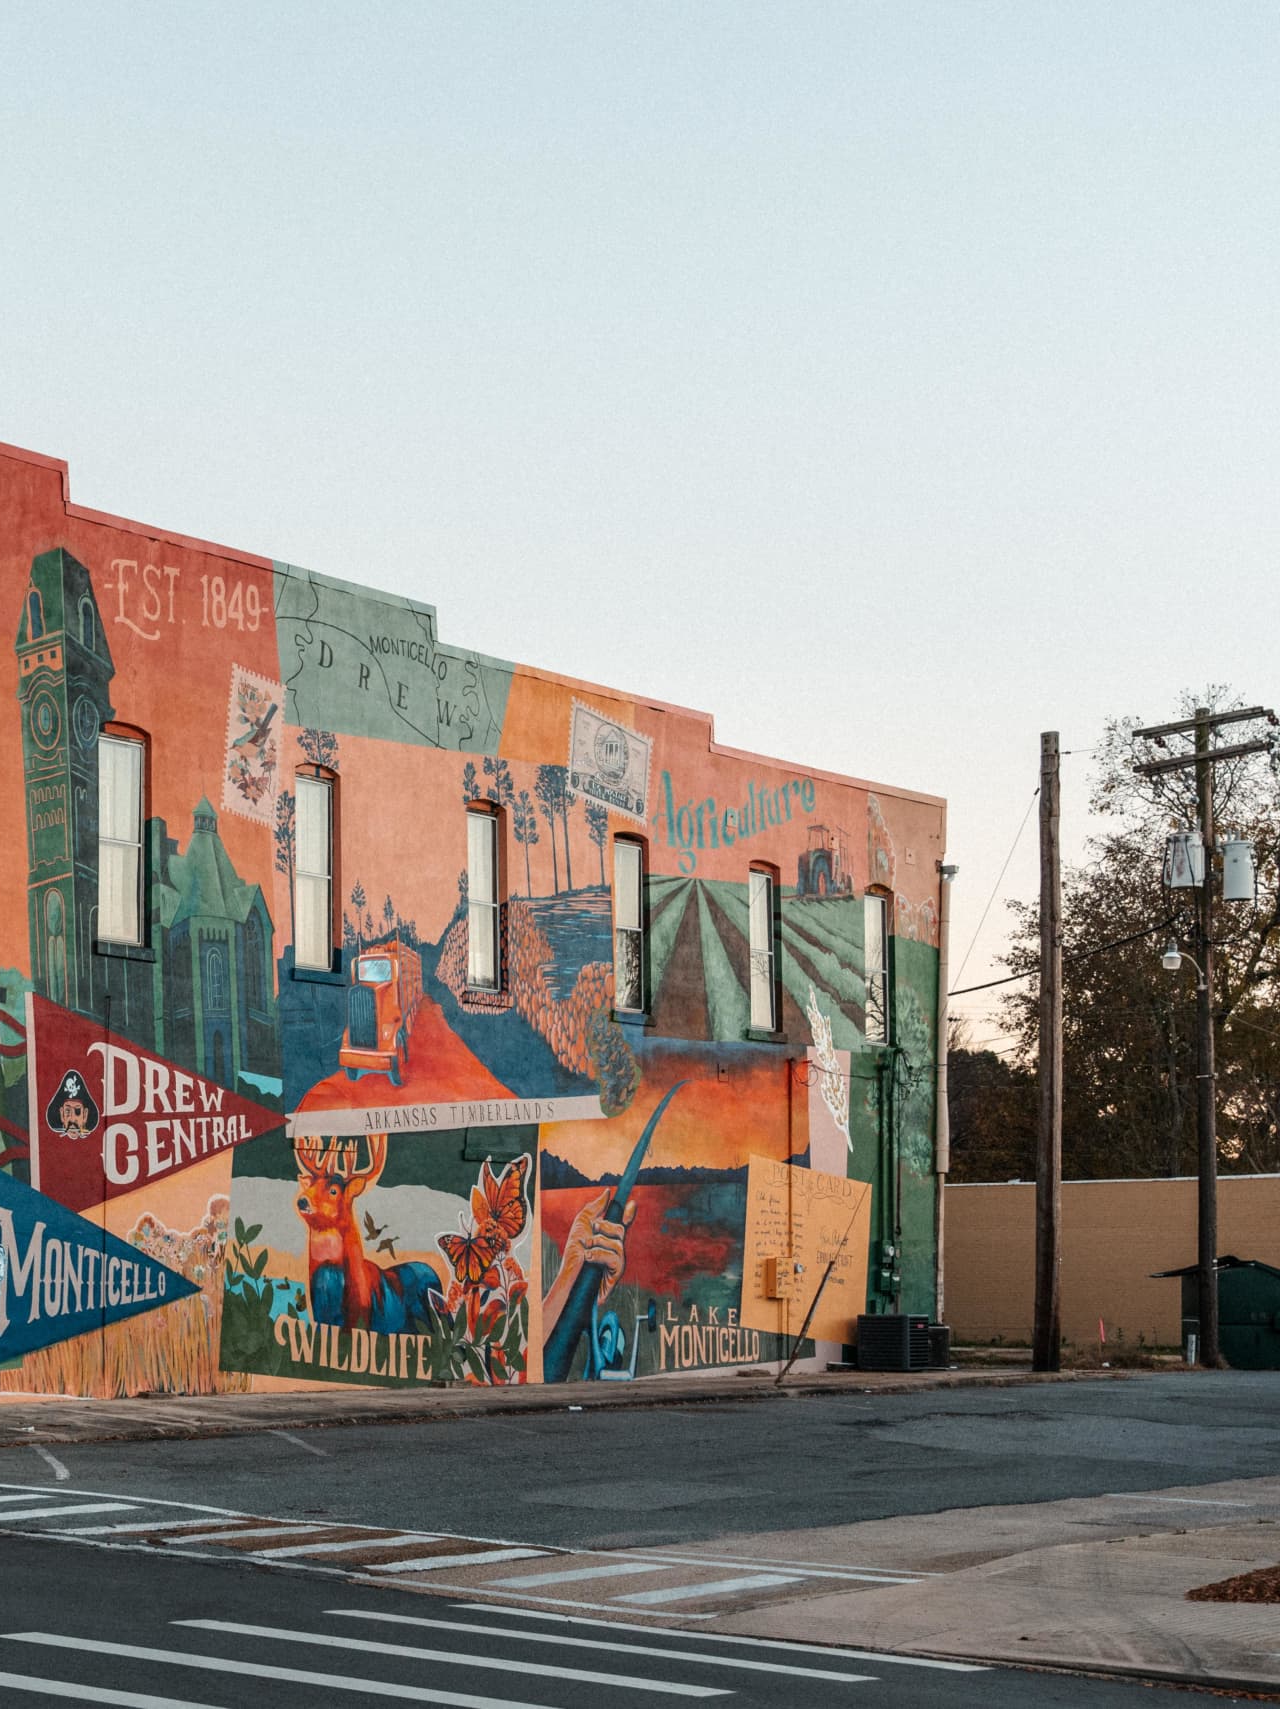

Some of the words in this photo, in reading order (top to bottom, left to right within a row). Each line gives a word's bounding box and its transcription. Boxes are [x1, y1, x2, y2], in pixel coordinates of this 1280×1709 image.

[318, 639, 458, 727] DREW
[369, 635, 448, 681] MONTICELLO
[651, 769, 816, 874] Agriculture
[86, 1041, 226, 1117] DREW
[101, 1113, 253, 1185] CENTRAL
[364, 1106, 438, 1131] ARKANSAS
[448, 1101, 555, 1124] TIMBERLANDS
[273, 1313, 433, 1380] WILDLIFE
[658, 1323, 760, 1370] MONTICELLO
[666, 1301, 738, 1327] LAKE
